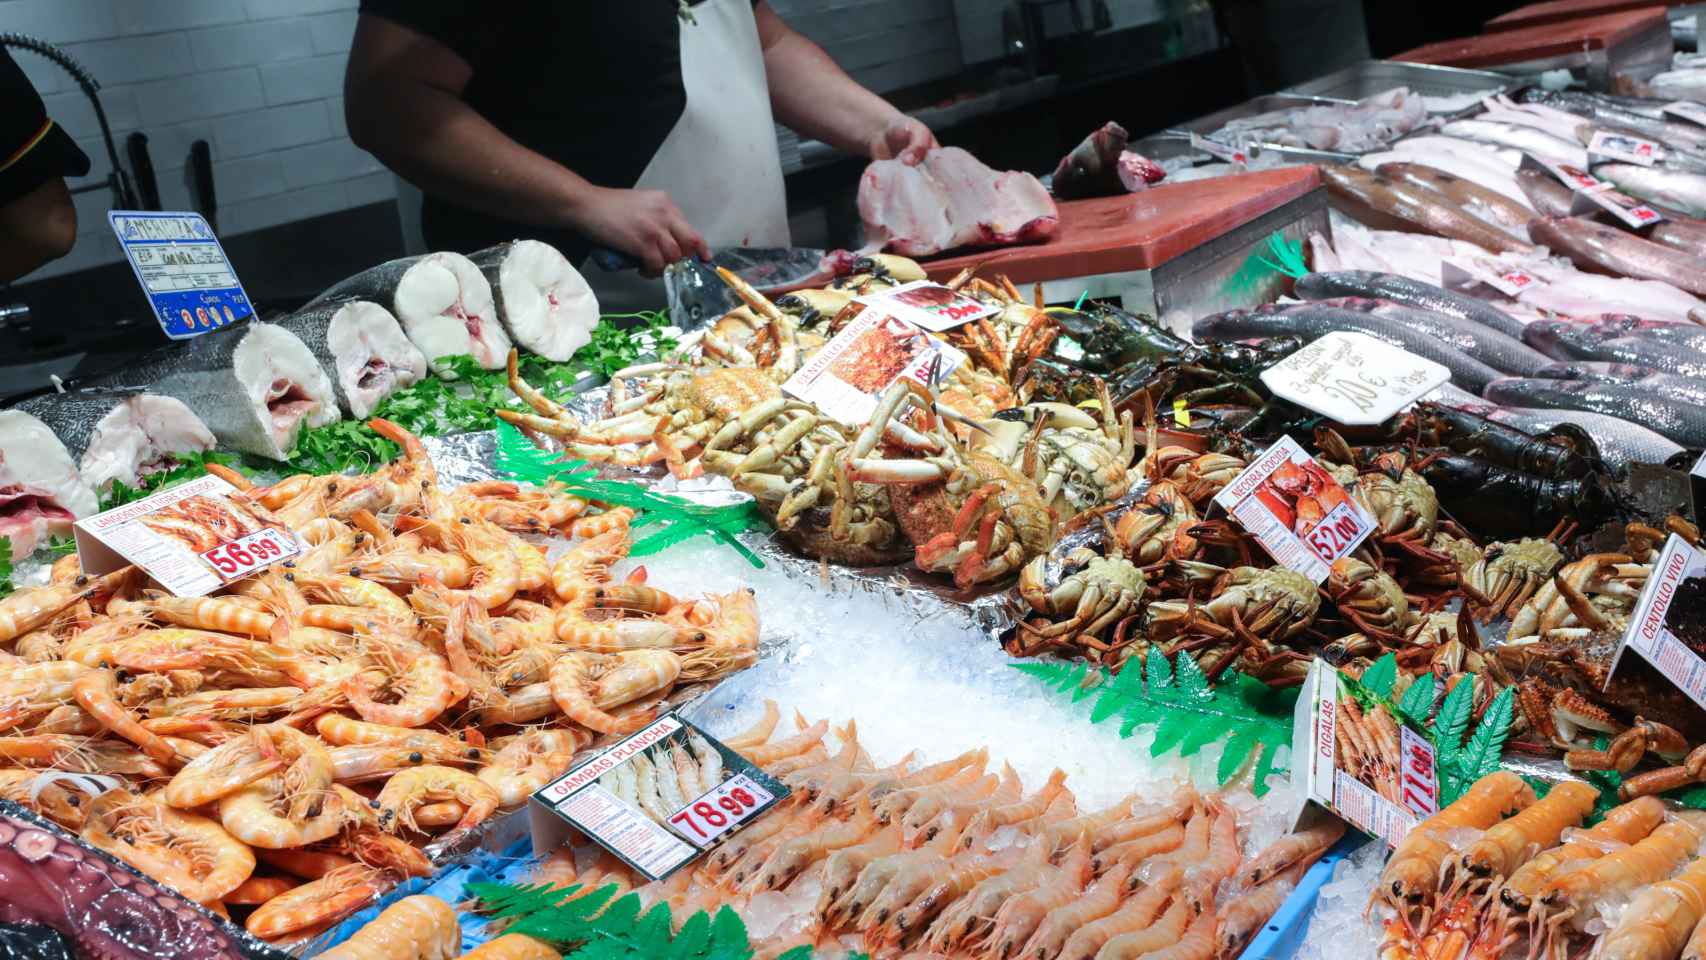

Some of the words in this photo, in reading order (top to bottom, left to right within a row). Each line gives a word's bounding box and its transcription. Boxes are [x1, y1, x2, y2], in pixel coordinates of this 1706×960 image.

[796, 341, 842, 386] CENTOLLO
[1261, 446, 1291, 473] COCIDA
[93, 501, 154, 529] LANGOSTINO
[154, 491, 179, 511] TIGRE
[179, 480, 216, 499] COCIDO
[1641, 583, 1674, 641] CENTOLLO
[1668, 552, 1685, 582] VIVO
[1320, 699, 1335, 758] CIGALAS
[554, 759, 614, 796] GAMBAS
[615, 722, 674, 763] PLANCHA
